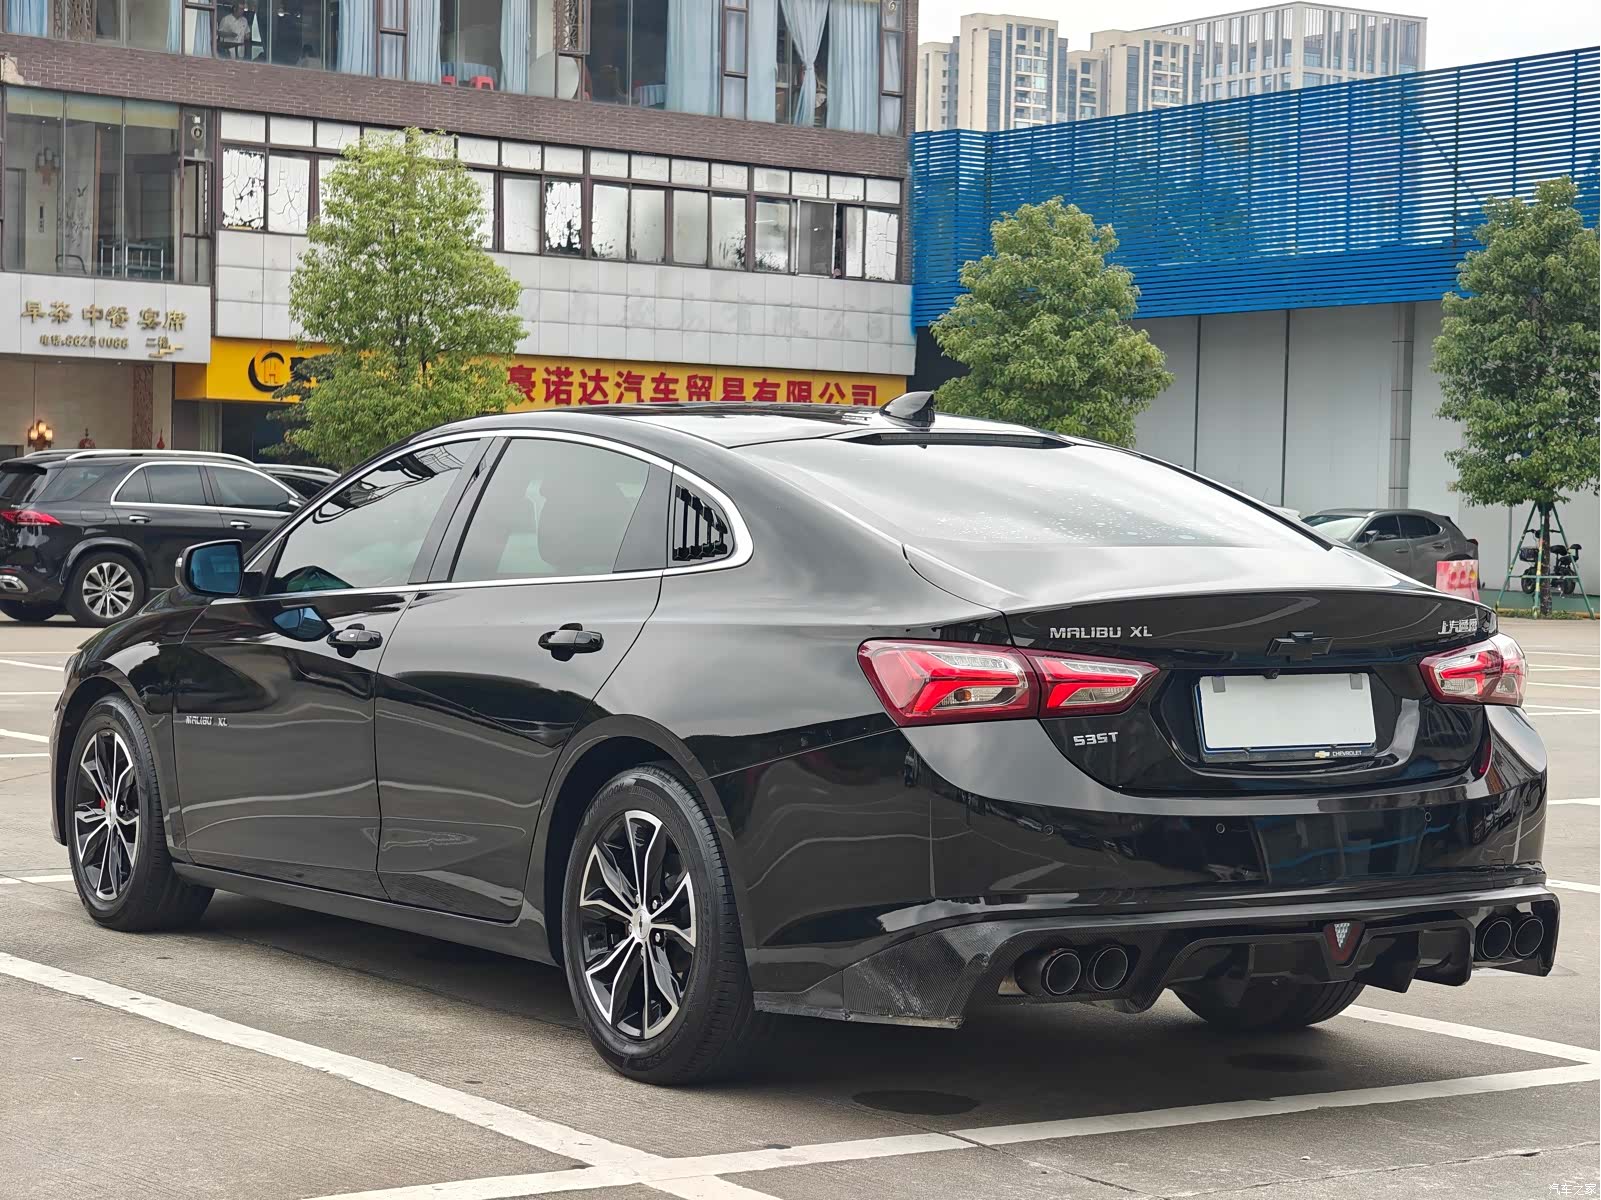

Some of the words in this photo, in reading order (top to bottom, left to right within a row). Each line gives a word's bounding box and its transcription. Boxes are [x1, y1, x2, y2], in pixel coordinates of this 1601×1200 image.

[21, 301, 73, 324] 早茶
[82, 304, 129, 328] 中餐
[1049, 627, 1122, 639] MALIBU
[1129, 626, 1153, 638] XL
[185, 715, 213, 726] MALIBU
[217, 717, 228, 727] XL
[1073, 731, 1119, 746] 535T
